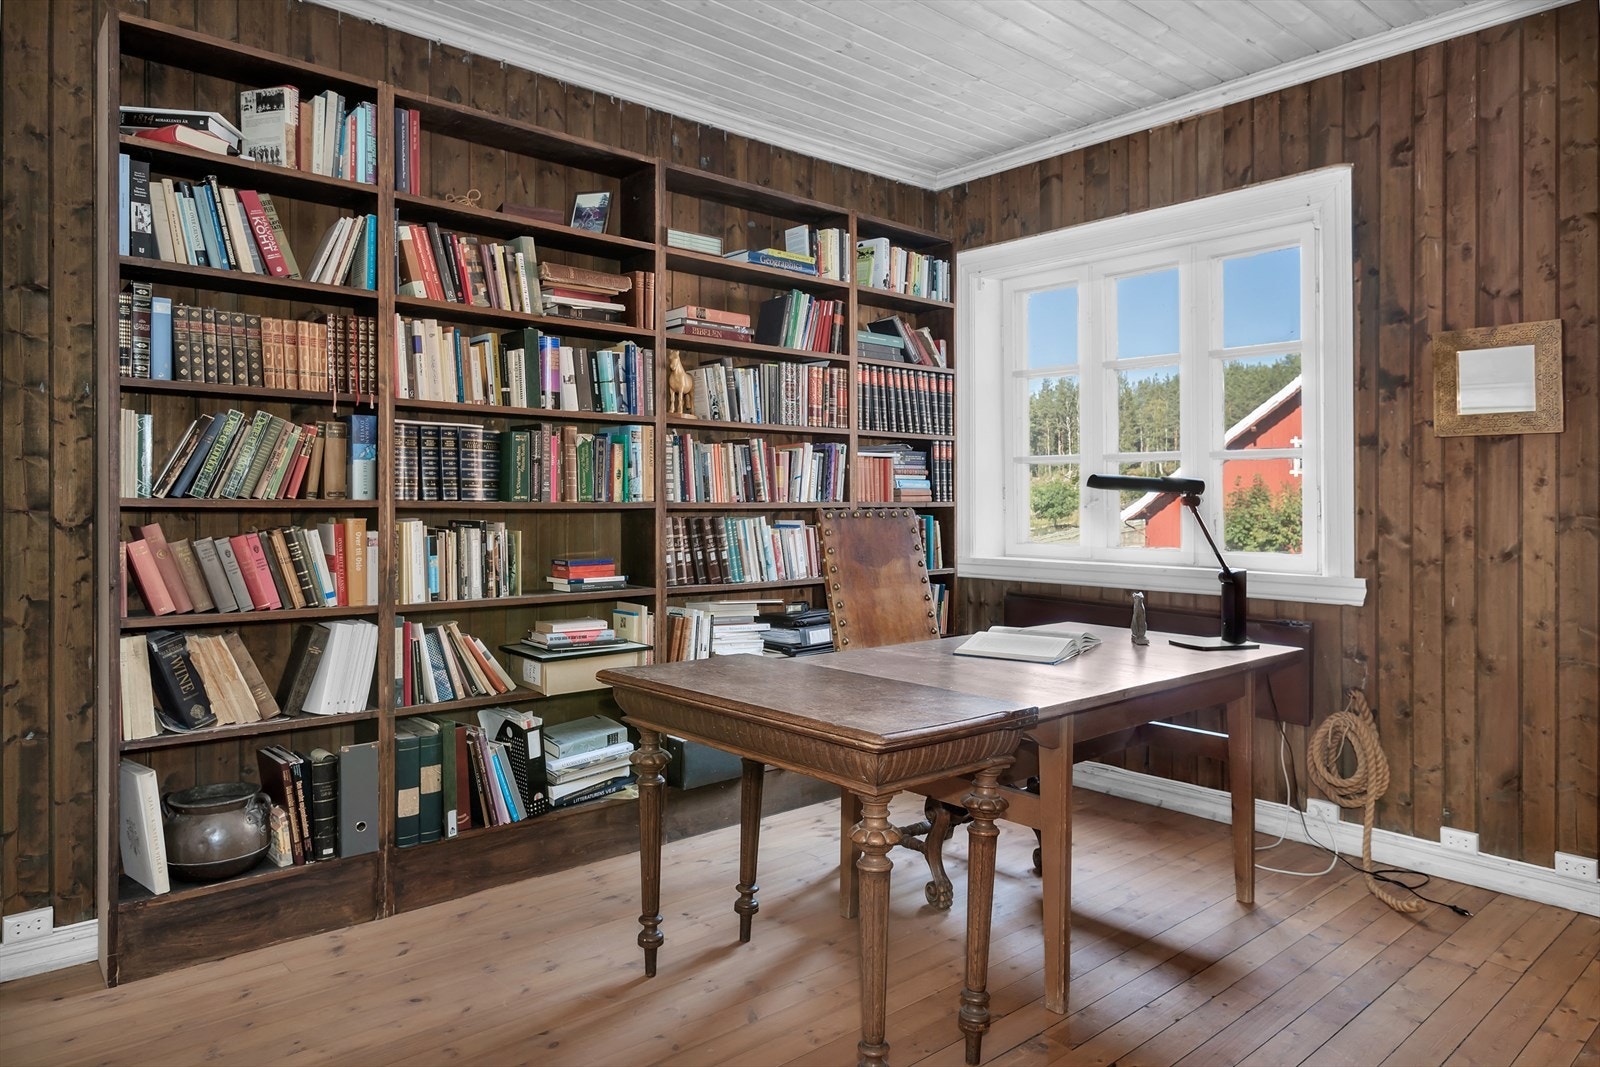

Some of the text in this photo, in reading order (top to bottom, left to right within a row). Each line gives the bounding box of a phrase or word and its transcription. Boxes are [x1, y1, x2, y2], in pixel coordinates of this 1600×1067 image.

[132, 112, 154, 124] 1814
[252, 216, 274, 251] KOHT
[260, 216, 278, 251] HALVDAN
[760, 256, 803, 272] Geographica
[692, 327, 722, 339] BIBELEN
[218, 434, 226, 443] er
[205, 442, 225, 474] London
[235, 444, 253, 474] London
[171, 655, 195, 694] WINE
[573, 786, 617, 804] LITTERATURENS VEJE
